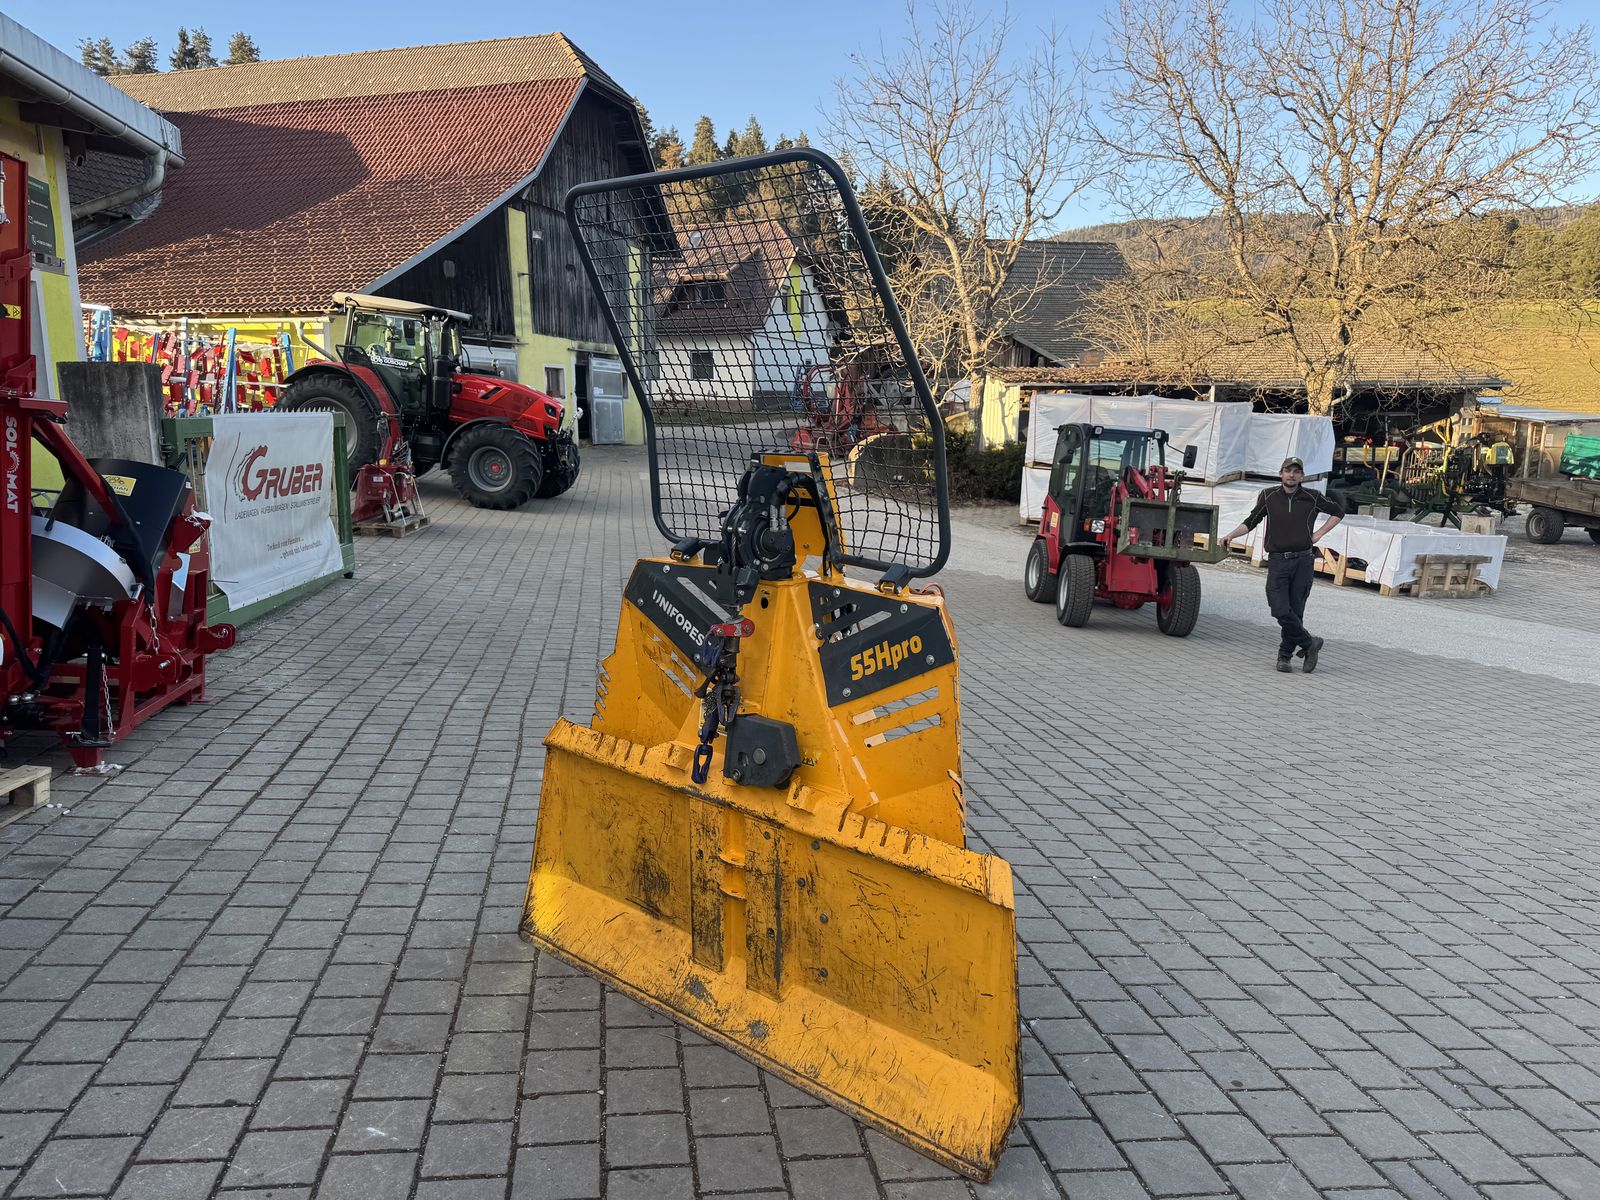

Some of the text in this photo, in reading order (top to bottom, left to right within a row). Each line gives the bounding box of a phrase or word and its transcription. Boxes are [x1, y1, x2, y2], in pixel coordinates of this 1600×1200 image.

[242, 445, 323, 501] GRUBER
[652, 589, 712, 646] UNIFORES
[850, 635, 923, 681] 55Hpro
